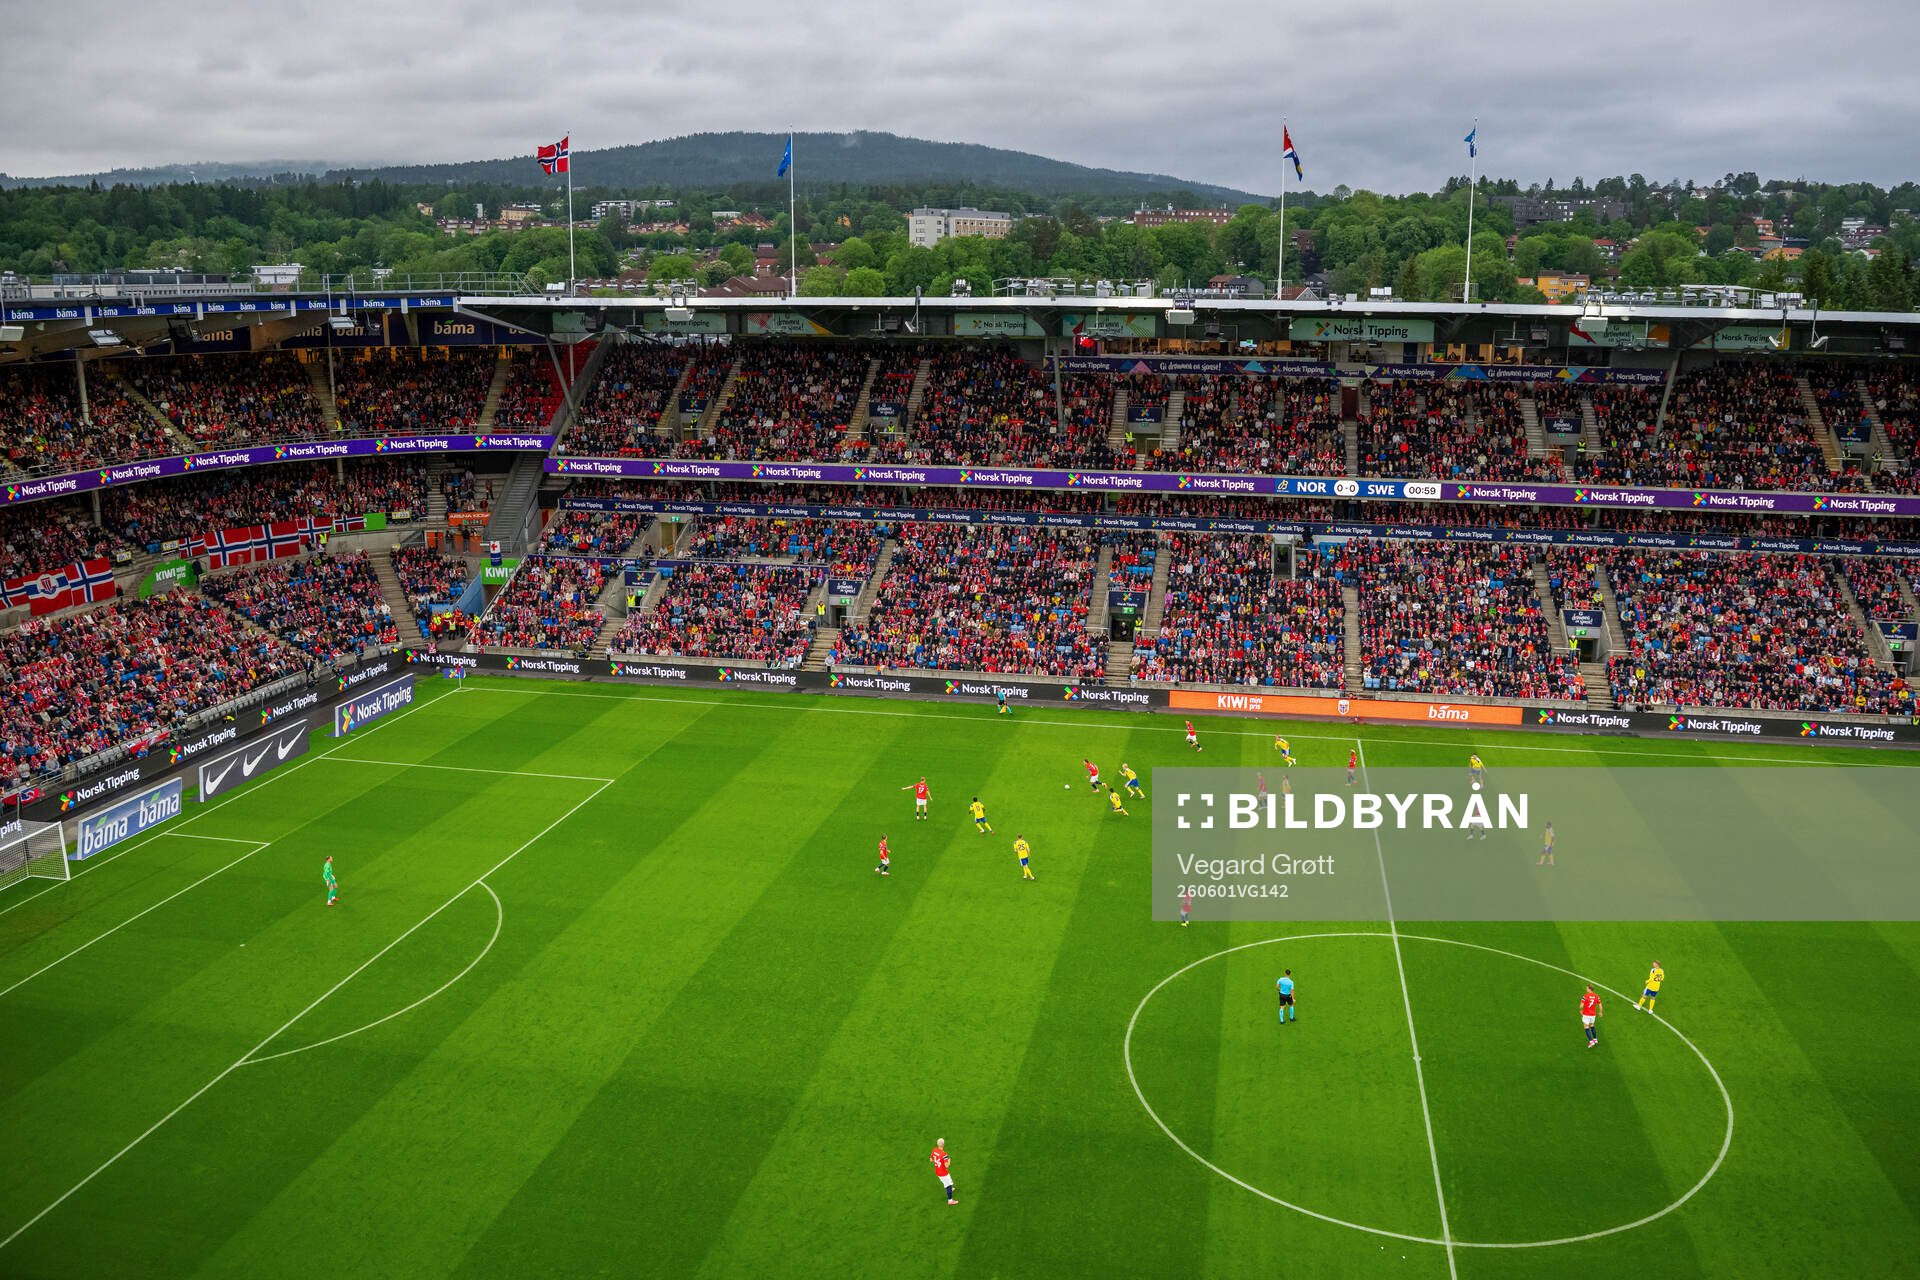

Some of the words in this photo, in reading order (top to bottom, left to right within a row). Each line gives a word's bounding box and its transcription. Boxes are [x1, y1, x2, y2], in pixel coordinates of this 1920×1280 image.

[433, 320, 475, 335] bama
[983, 320, 1003, 328] Nosk
[1333, 324, 1363, 336] Norsk
[1367, 325, 1408, 339] Tipping
[1722, 333, 1743, 342] Norsk
[1069, 361, 1087, 369] Norsk
[1088, 361, 1110, 371] Tipping
[1283, 365, 1301, 373] Norsk
[1302, 365, 1325, 375] Tipping
[1393, 368, 1411, 377] Norsk
[1412, 369, 1435, 379] Tipping
[1616, 373, 1635, 381] Norsk
[1635, 373, 1660, 383] Tipping
[391, 439, 415, 449] Norsk
[416, 439, 448, 448] Tipping
[489, 437, 512, 446] Norsk
[512, 438, 541, 447] Tipping
[290, 446, 315, 455] Norsk
[316, 445, 347, 455] Tipping
[196, 456, 218, 466] Norsk
[219, 453, 249, 464] Tipping
[113, 469, 133, 479] Norsk
[134, 466, 160, 476] Tipping
[570, 461, 592, 471] Norsk
[593, 463, 621, 473] Tipping
[667, 464, 689, 474] Norsk
[690, 465, 719, 476] Tipping
[766, 467, 789, 477] Norsk
[791, 468, 821, 478] Tipping
[869, 469, 893, 479] Norsk
[894, 471, 925, 481] Tipping
[975, 472, 999, 482] Norsk
[1000, 473, 1032, 484] Tipping
[1083, 475, 1108, 485] Norsk
[1110, 477, 1142, 487] Tipping
[22, 483, 46, 495] Norsk
[46, 479, 76, 492] Tipping
[1194, 478, 1220, 488] Norsk
[1221, 480, 1254, 491] Tipping
[1297, 481, 1326, 493] NOR
[1367, 484, 1395, 495] SWE
[1408, 486, 1436, 495] 00:59
[1474, 488, 1500, 497] Norsk
[1502, 489, 1536, 500] Tipping
[1591, 492, 1618, 501] Norsk
[1620, 493, 1655, 504] Tipping
[1710, 496, 1738, 505] Norsk
[1739, 497, 1774, 508] Tipping
[1831, 500, 1858, 509] Norsk
[1860, 500, 1896, 512] Tipping
[686, 505, 703, 513] Tipping
[738, 506, 755, 515] Tipping
[790, 508, 808, 516] Tipping
[843, 510, 861, 518] Tipping
[897, 511, 915, 520] Tipping
[951, 513, 970, 521] Tipping
[1007, 515, 1025, 523] Tipping
[1047, 516, 1062, 524] Norsk
[1063, 517, 1081, 525] Tipping
[1119, 519, 1138, 527] Tipping
[1161, 520, 1176, 528] Norsk
[1177, 521, 1196, 529] Tipping
[1219, 522, 1234, 530] Norsk
[1235, 523, 1254, 531] Tipping
[1351, 527, 1372, 535] Tipping
[1412, 529, 1432, 538] Tipping
[1456, 530, 1471, 538] Norsk
[1472, 531, 1492, 540] Tipping
[1516, 532, 1532, 540] Norsk
[1533, 533, 1552, 542] Tipping
[1593, 535, 1614, 544] Tipping
[1655, 537, 1675, 546] Tipping
[1779, 542, 1799, 551] Tipping
[1840, 544, 1862, 553] Tipping
[155, 568, 176, 582] KIWI
[485, 567, 508, 578] KIWI
[444, 655, 476, 668] Tipping
[521, 660, 546, 669] Norsk
[547, 661, 579, 673] Tipping
[349, 671, 366, 684] Norsk
[366, 663, 387, 677] Tipping
[626, 666, 651, 675] Norsk
[651, 667, 686, 679] Tipping
[734, 672, 761, 681] Norsk
[762, 673, 796, 685] Tipping
[847, 677, 874, 687] Norsk
[875, 679, 910, 691] Tipping
[962, 684, 990, 694] Norsk
[992, 685, 1028, 698] Tpping
[1082, 690, 1110, 700] Norsk
[1112, 691, 1149, 704] Tipping
[273, 702, 292, 717] Norsk
[292, 693, 317, 709] Tipping
[358, 697, 381, 721] Norsk
[382, 687, 411, 710] Tipping
[1217, 695, 1247, 709] KIWI
[1249, 696, 1262, 704] mini
[1557, 713, 1588, 723] Norsk
[1590, 715, 1630, 728] Tipping
[1688, 719, 1719, 730] Norsk
[1721, 721, 1761, 734] Tipping
[1820, 726, 1852, 736] Norsk
[1854, 727, 1895, 740] Tipping
[184, 738, 207, 755] Norsk
[208, 728, 236, 745] Tipping
[77, 782, 105, 801] Norsk
[105, 769, 139, 788] Tipping
[138, 792, 179, 828] bama
[84, 817, 128, 854] bama
[1588, 999, 1595, 1008] 7
